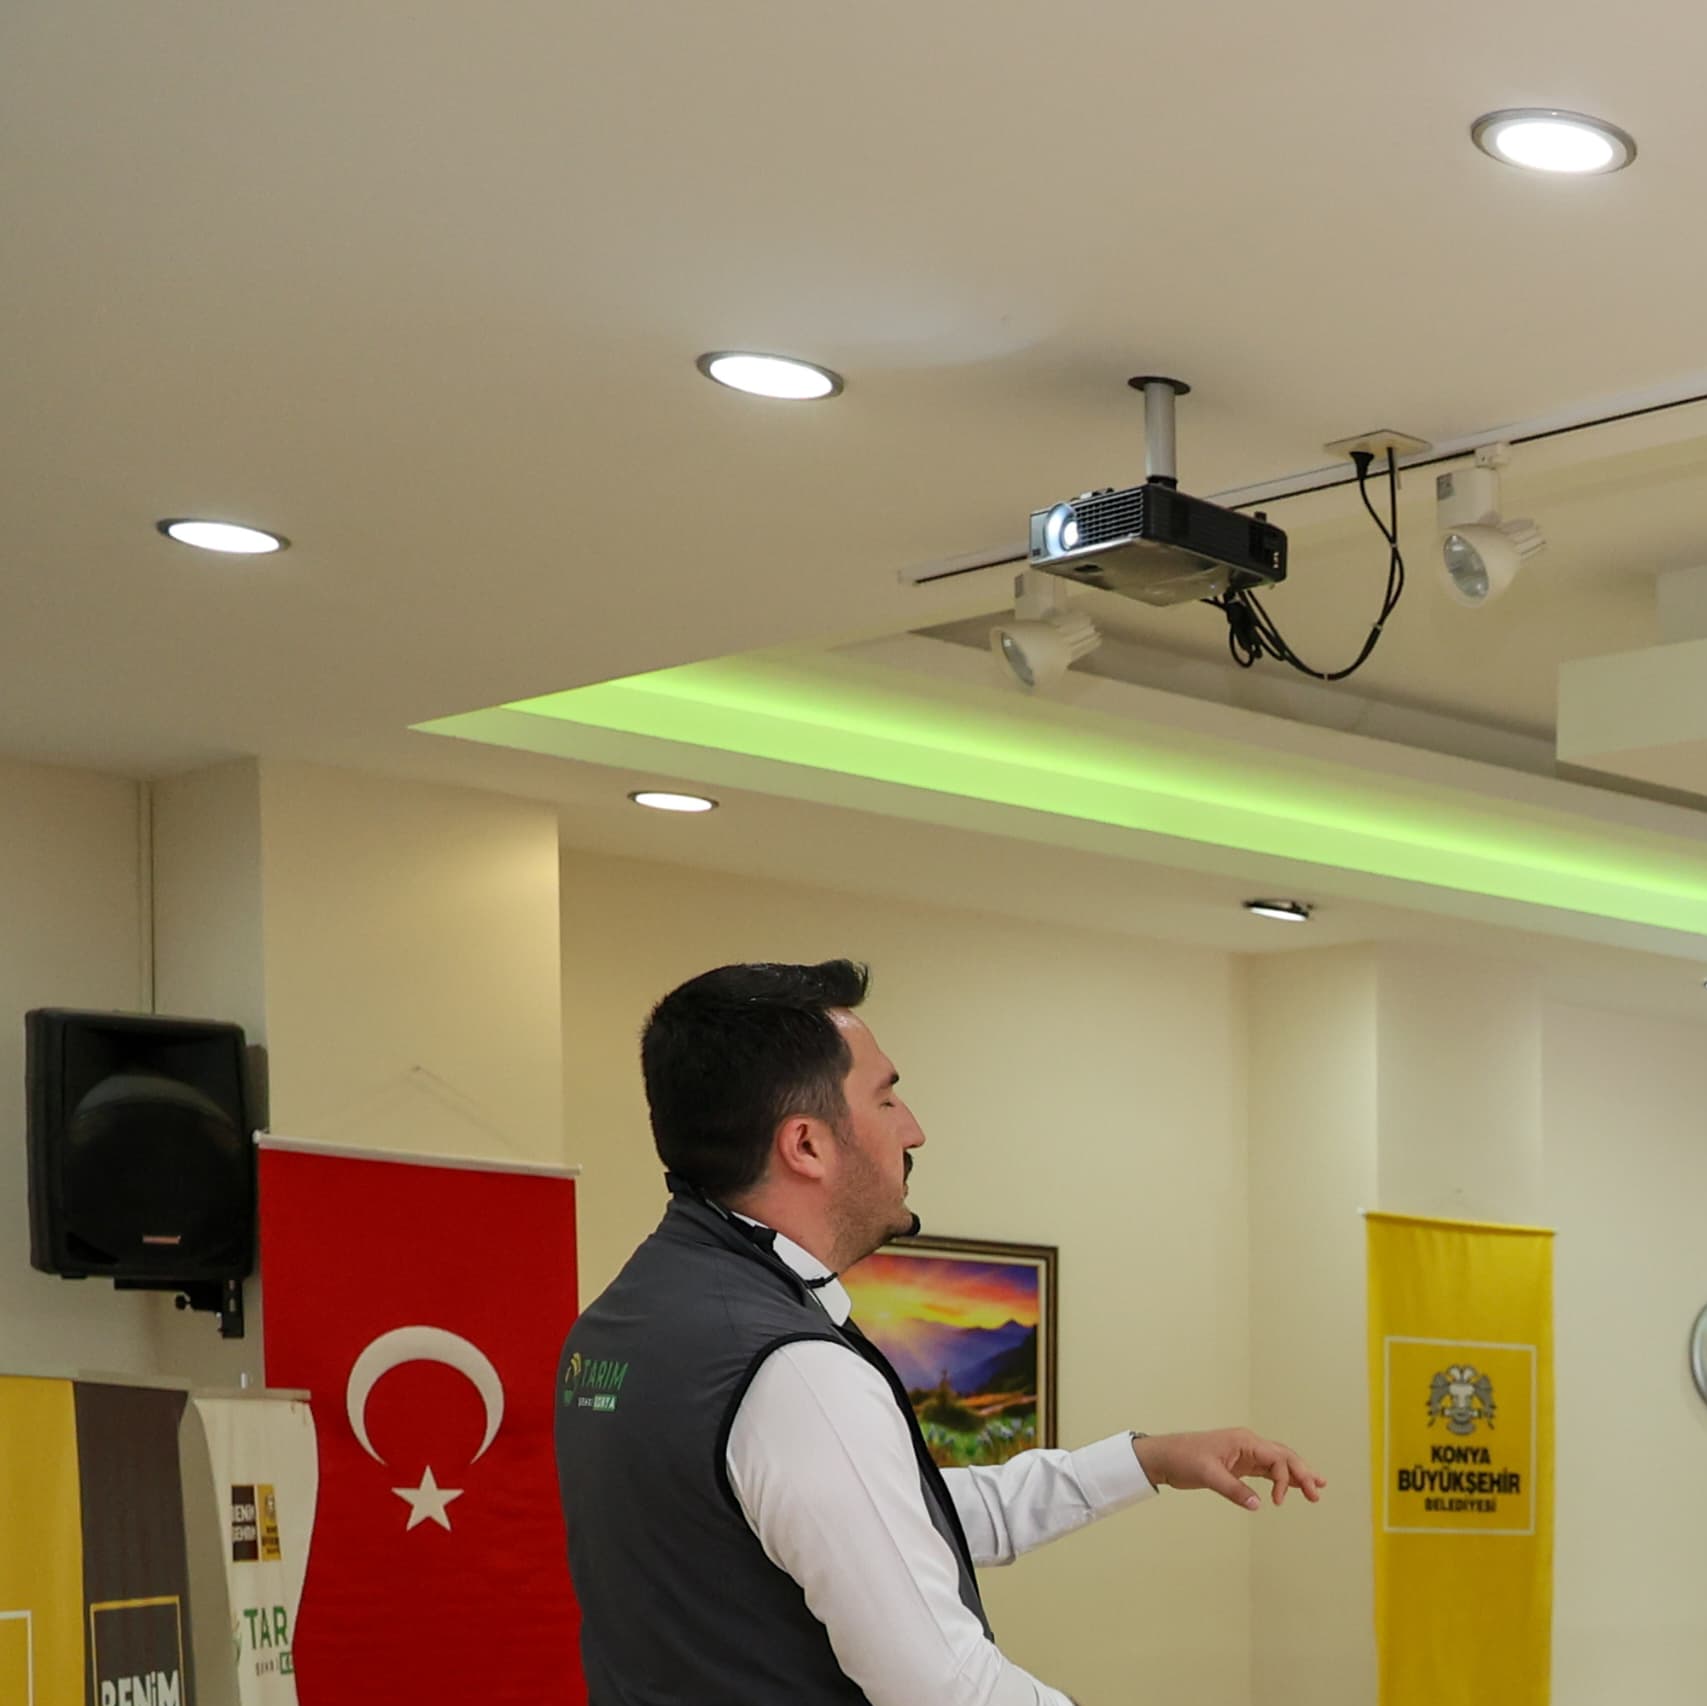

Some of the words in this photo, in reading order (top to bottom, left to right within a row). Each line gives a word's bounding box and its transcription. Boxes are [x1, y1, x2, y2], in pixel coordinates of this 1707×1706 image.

[582, 1359, 629, 1391] TARIM
[1431, 1445, 1491, 1464] KONYA
[1397, 1464, 1521, 1495] BÜYÜKŞEHİR
